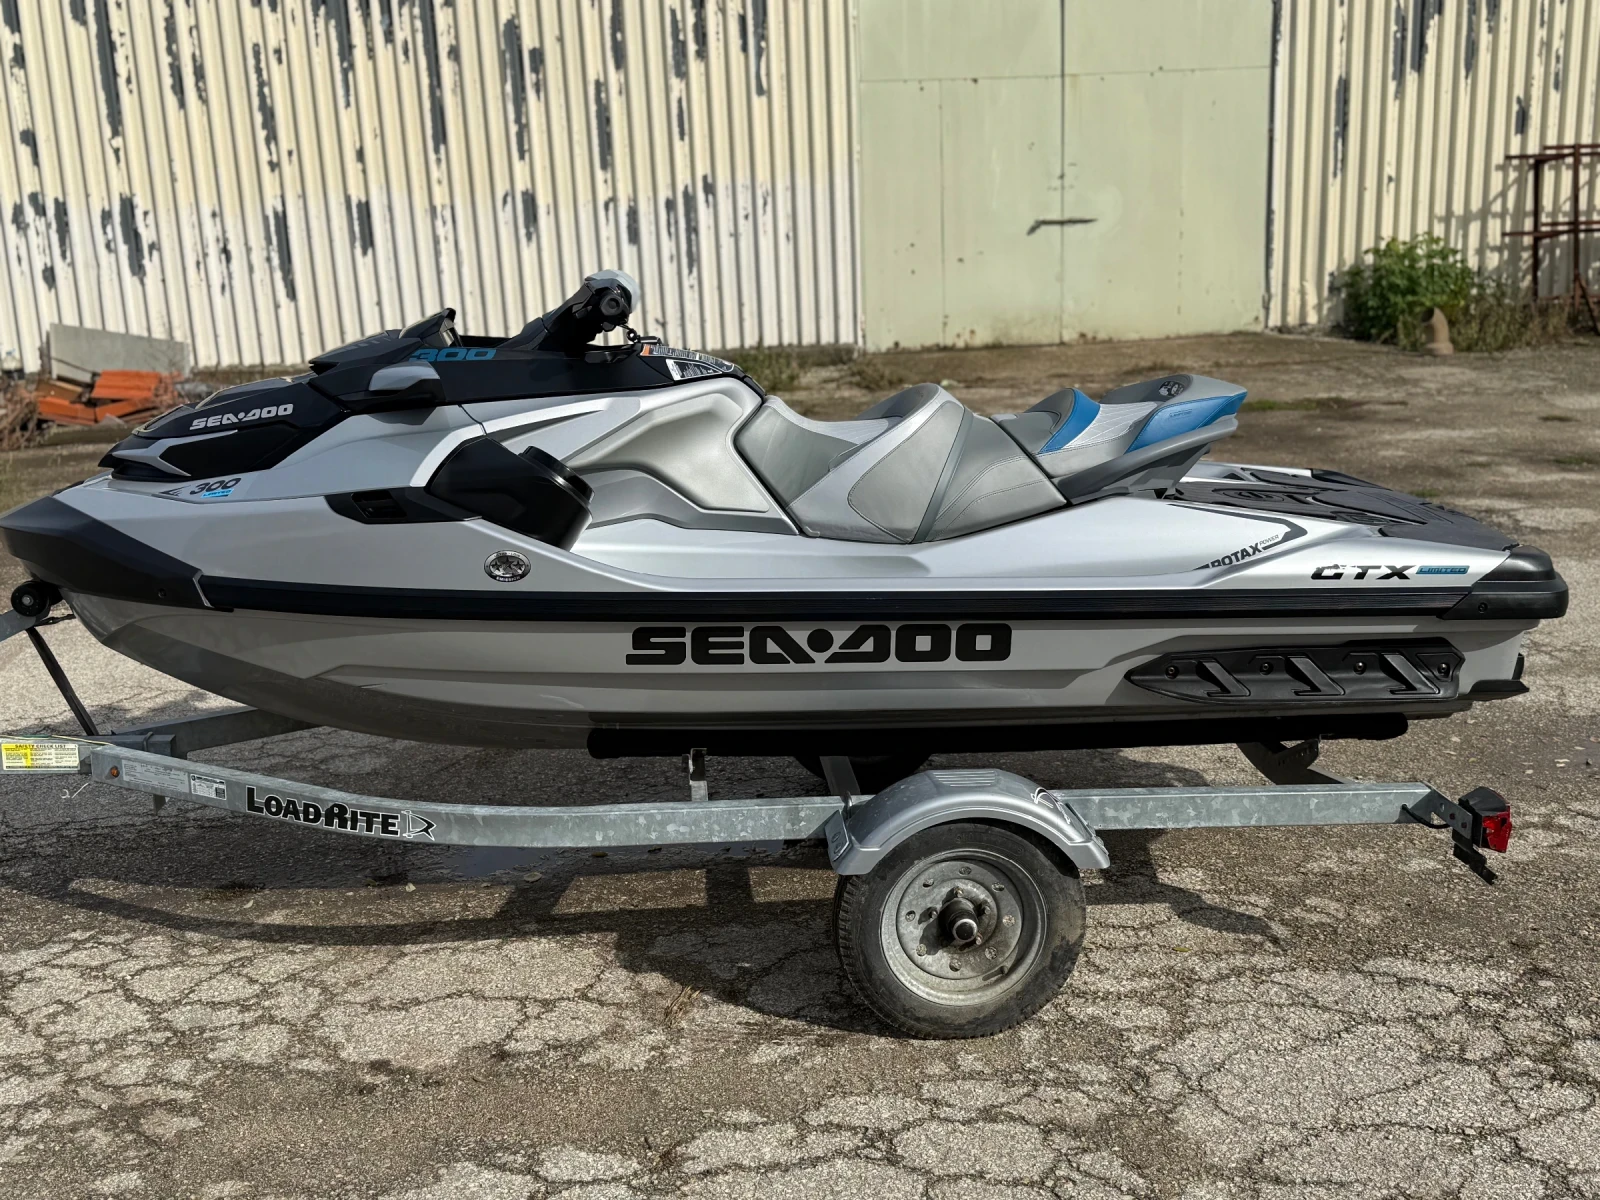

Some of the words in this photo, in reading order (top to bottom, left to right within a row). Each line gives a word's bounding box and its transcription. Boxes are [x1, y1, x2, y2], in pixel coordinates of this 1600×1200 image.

[409, 348, 496, 361] 300
[189, 477, 242, 495] 300
[1210, 542, 1262, 569] ROTAX
[1259, 534, 1280, 546] POWER
[1310, 564, 1417, 580] GTX
[1418, 566, 1468, 574] LIMITED
